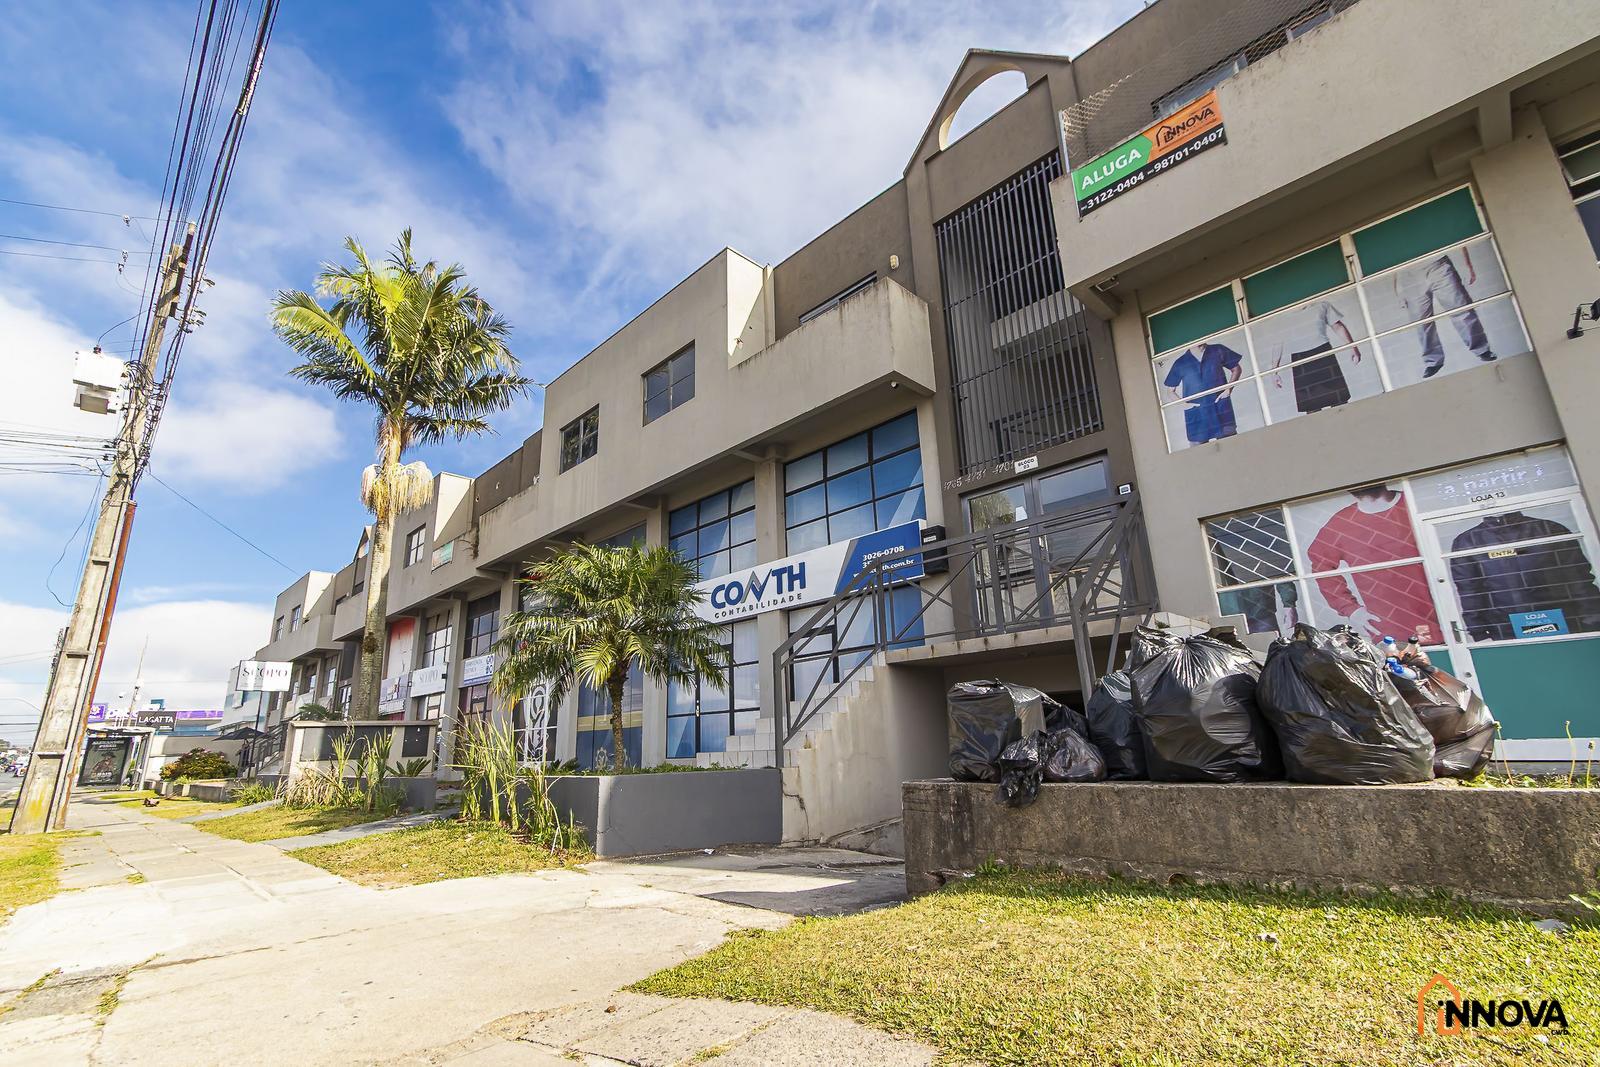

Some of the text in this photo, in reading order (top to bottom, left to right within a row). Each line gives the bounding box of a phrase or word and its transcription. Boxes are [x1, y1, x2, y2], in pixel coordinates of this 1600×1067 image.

[1081, 148, 1142, 190] ALUGA
[1471, 493, 1494, 503] LOJA
[862, 545, 905, 561] 3026-0708
[710, 561, 806, 610] CONTH
[714, 592, 802, 619] CONTABILIDADE
